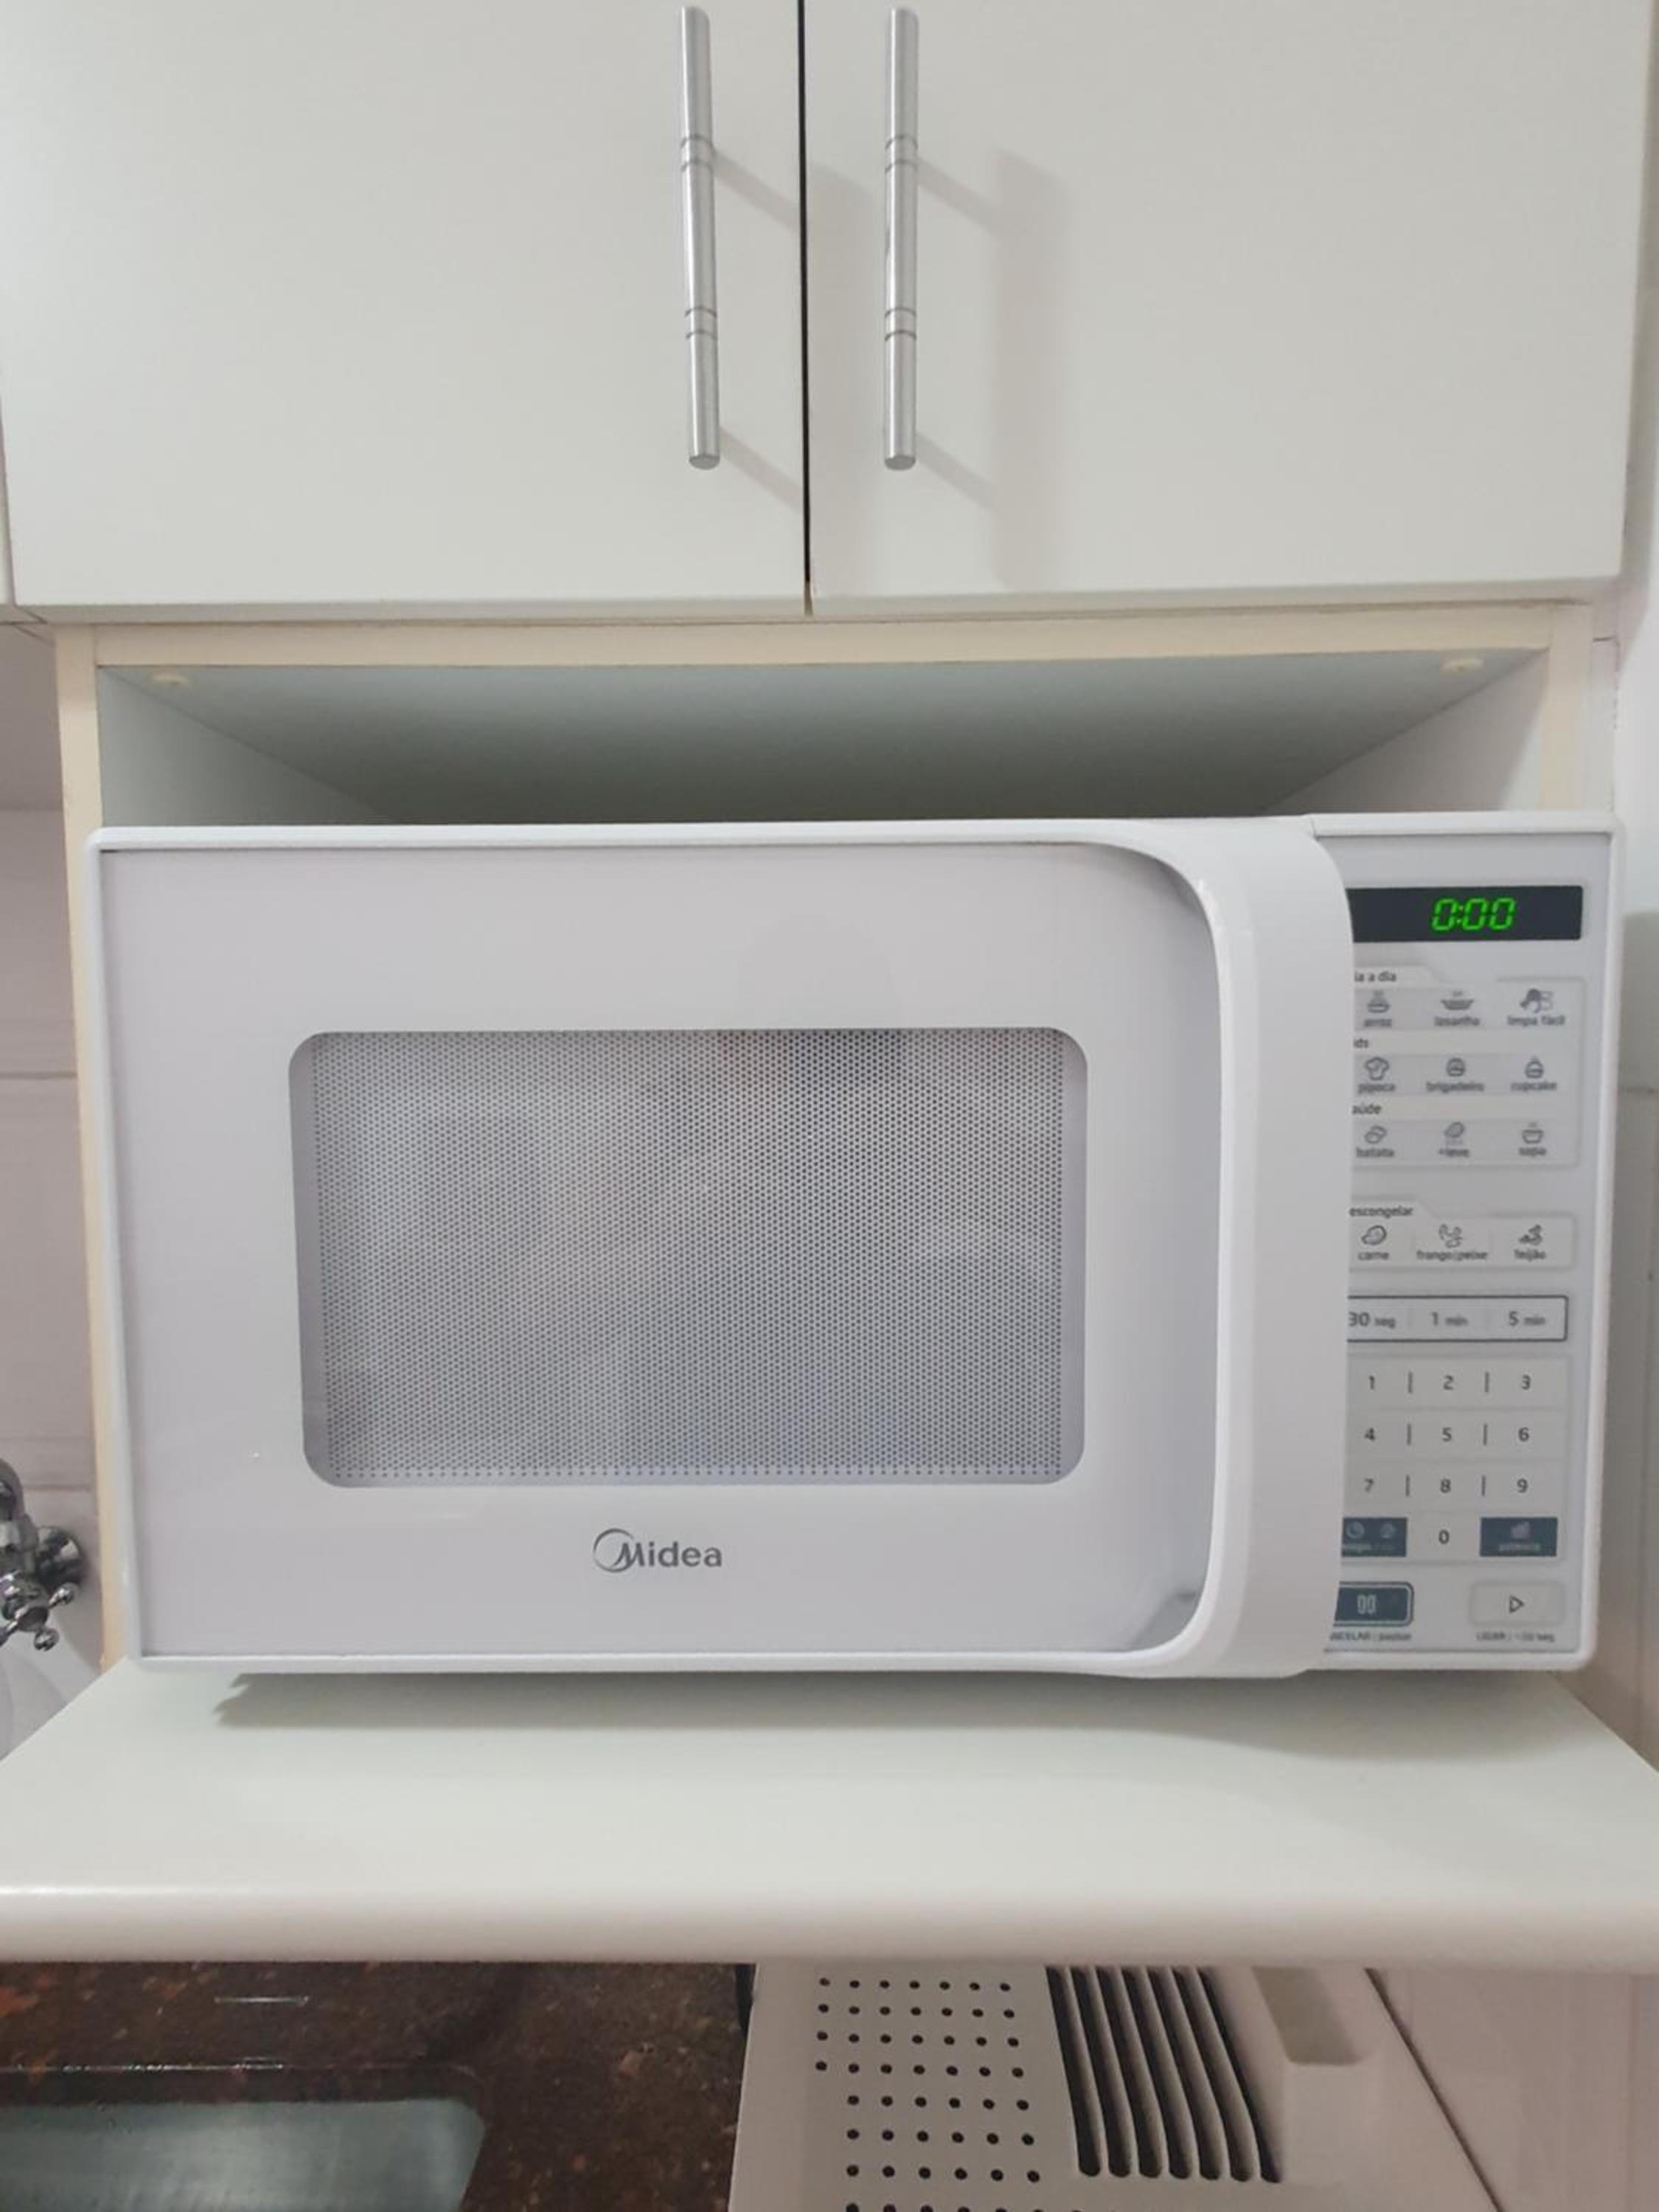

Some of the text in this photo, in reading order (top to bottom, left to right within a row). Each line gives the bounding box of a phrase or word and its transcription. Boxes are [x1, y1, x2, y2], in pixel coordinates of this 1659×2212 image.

[1431, 897, 1516, 932] 0:00
[1352, 1102, 1382, 1116] aúde
[1349, 1205, 1413, 1220] escongelar
[1357, 1251, 1391, 1261] carne
[1349, 1312, 1397, 1329] 30 seg
[1444, 1316, 1469, 1326] min
[1509, 1311, 1546, 1326] 5 min
[1368, 1375, 1376, 1390] 1
[1442, 1375, 1455, 1391] 2
[1521, 1374, 1531, 1391] 3
[1365, 1427, 1376, 1441] 4
[1441, 1427, 1453, 1442] 5
[1517, 1427, 1530, 1442] 6
[1365, 1478, 1374, 1492] 7
[1439, 1478, 1452, 1494] 8
[1517, 1478, 1528, 1493] 9
[1438, 1529, 1450, 1545] 0
[597, 1531, 723, 1572] Midea
